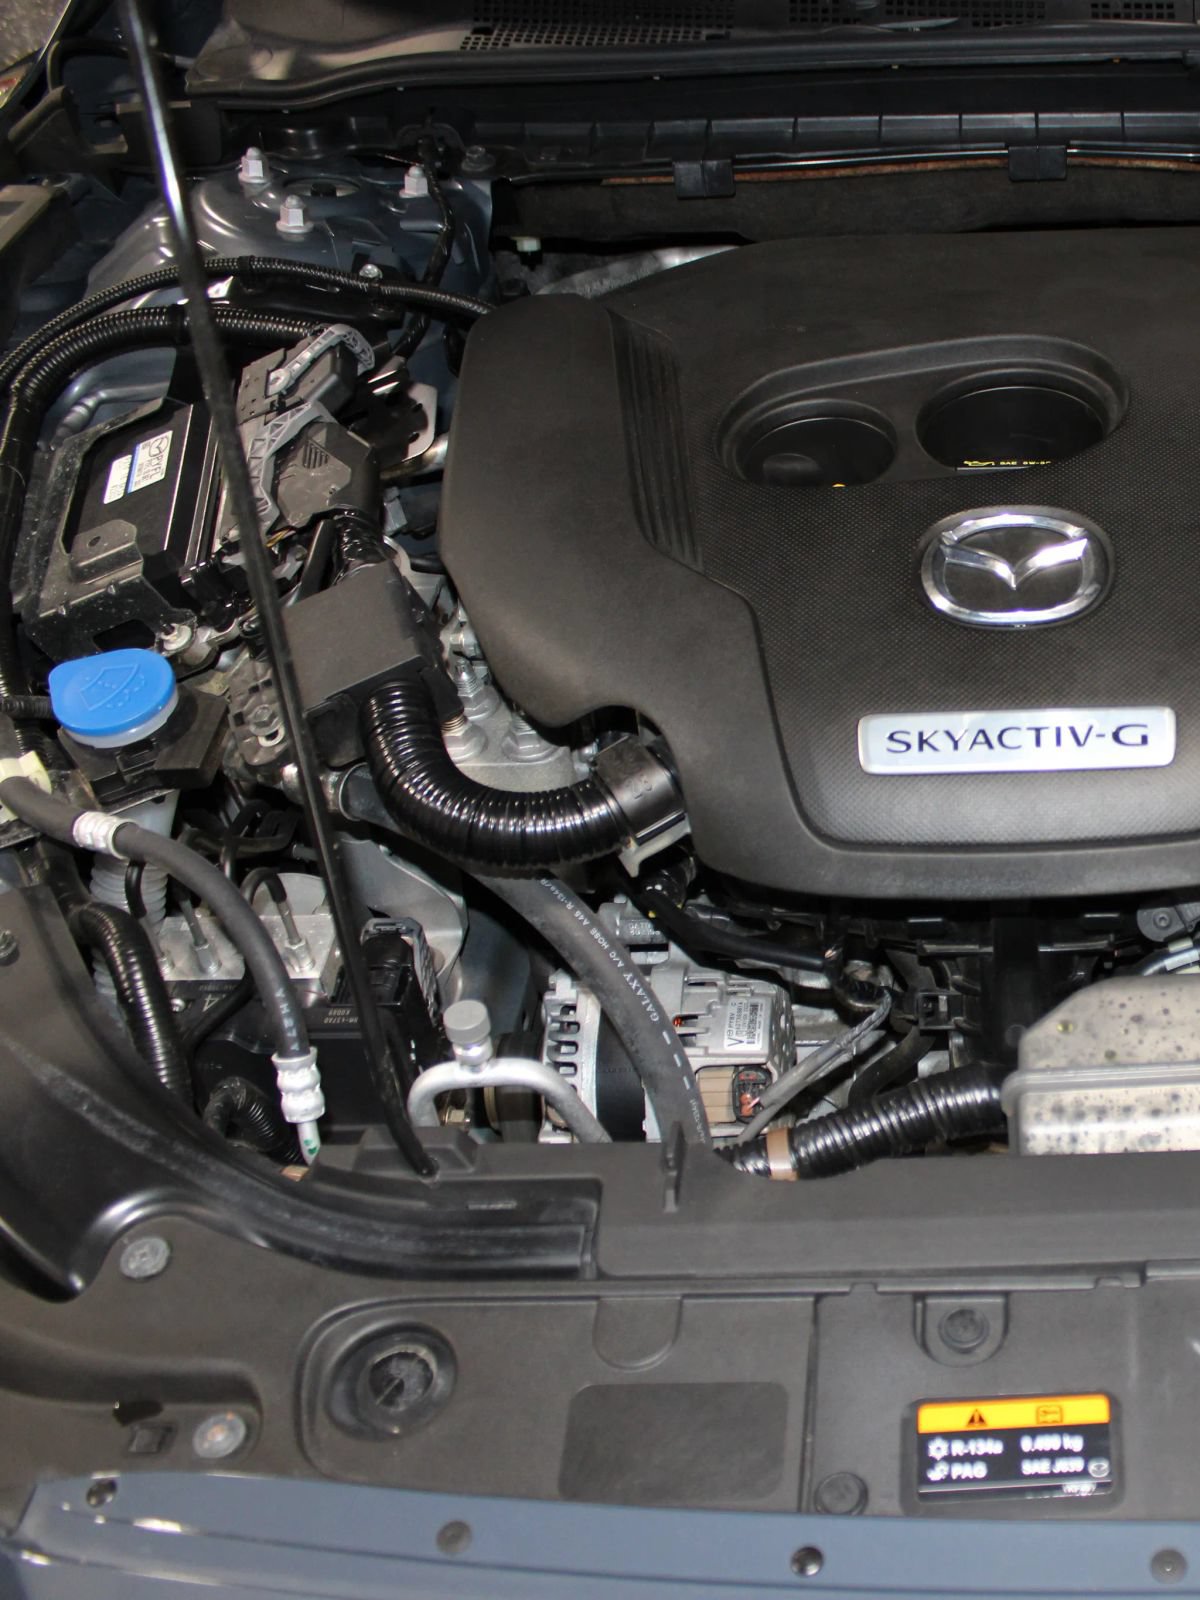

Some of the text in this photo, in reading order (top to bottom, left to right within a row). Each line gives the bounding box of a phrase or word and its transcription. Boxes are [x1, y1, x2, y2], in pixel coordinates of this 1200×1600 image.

[886, 724, 1149, 754] SKYACTIV-G
[589, 928, 610, 950] HOSE
[609, 951, 625, 968] A/C
[622, 972, 660, 1022] GALAXY
[950, 1437, 1004, 1457] R-134a
[1062, 1432, 1084, 1453] kg
[950, 1460, 988, 1480] PAG
[1021, 1457, 1051, 1476] SAE
